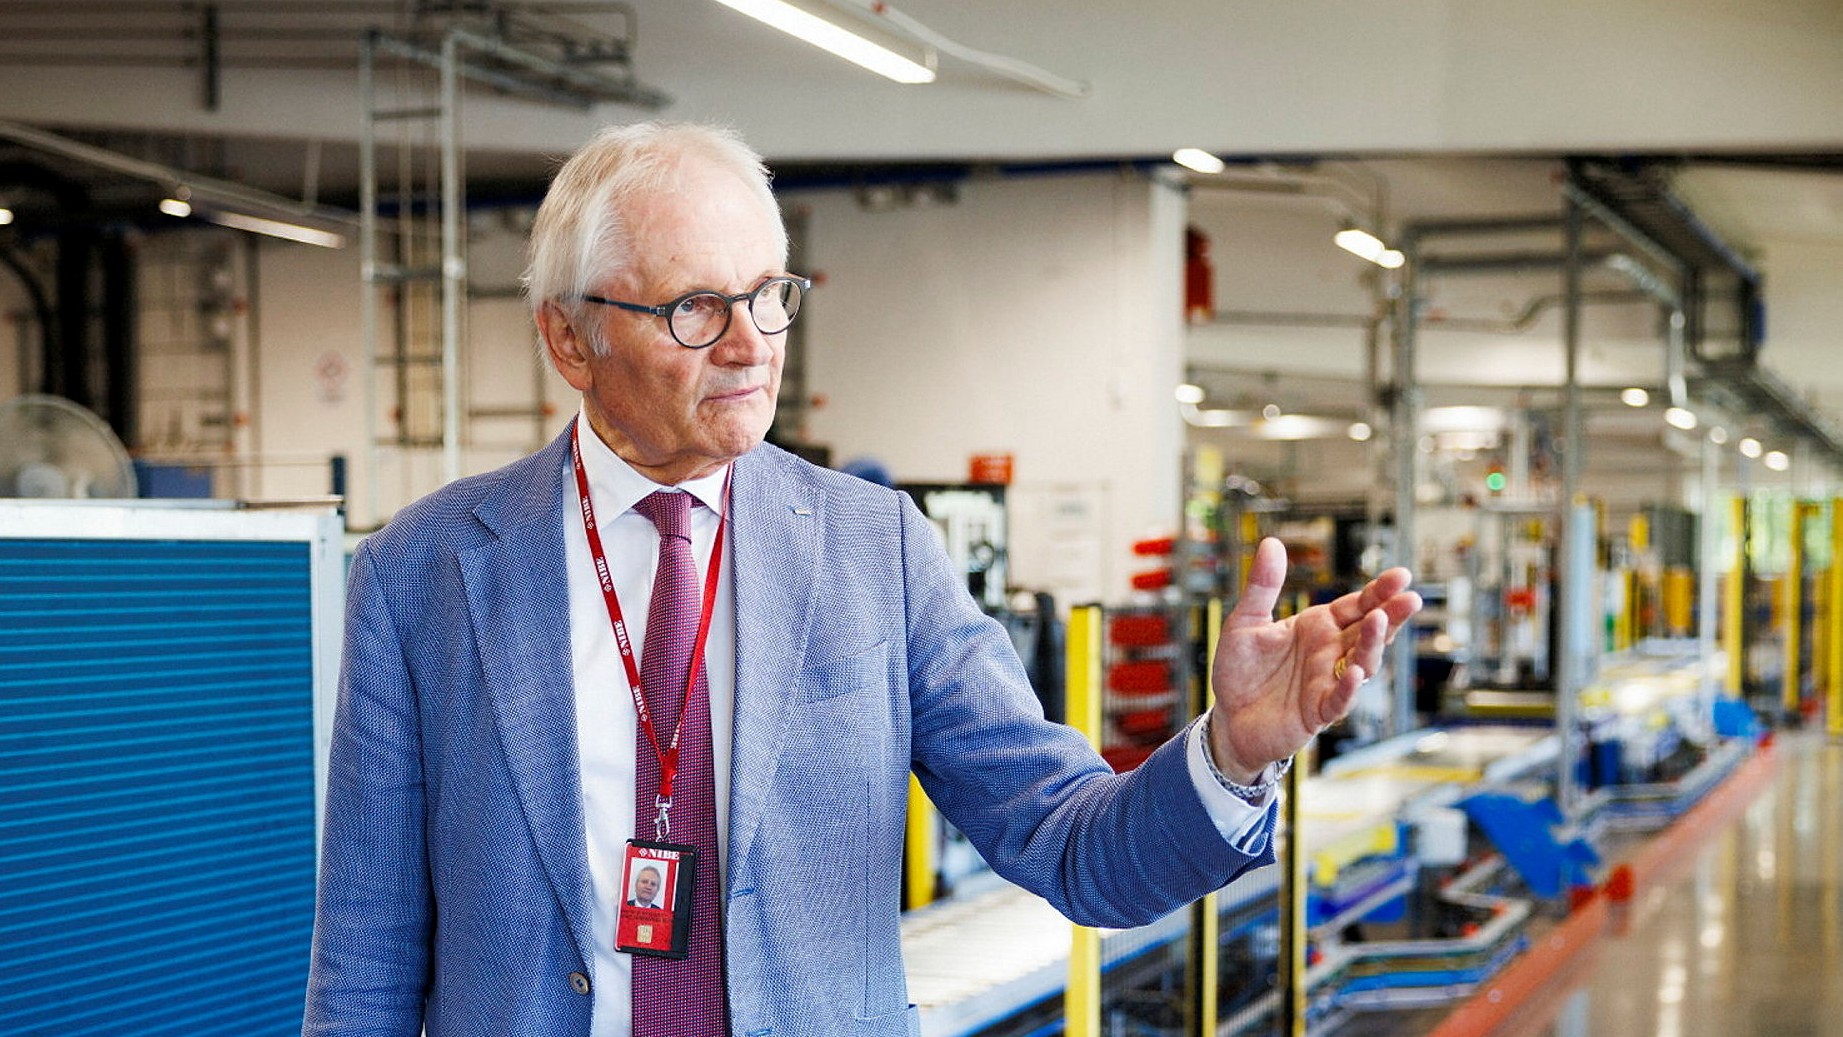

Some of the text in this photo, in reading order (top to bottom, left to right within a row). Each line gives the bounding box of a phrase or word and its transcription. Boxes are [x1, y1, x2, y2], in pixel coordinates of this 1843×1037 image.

[596, 556, 611, 584] NIBE
[613, 620, 629, 648] NIBE
[632, 685, 647, 714] NIBE
[648, 849, 680, 860] NIBE
